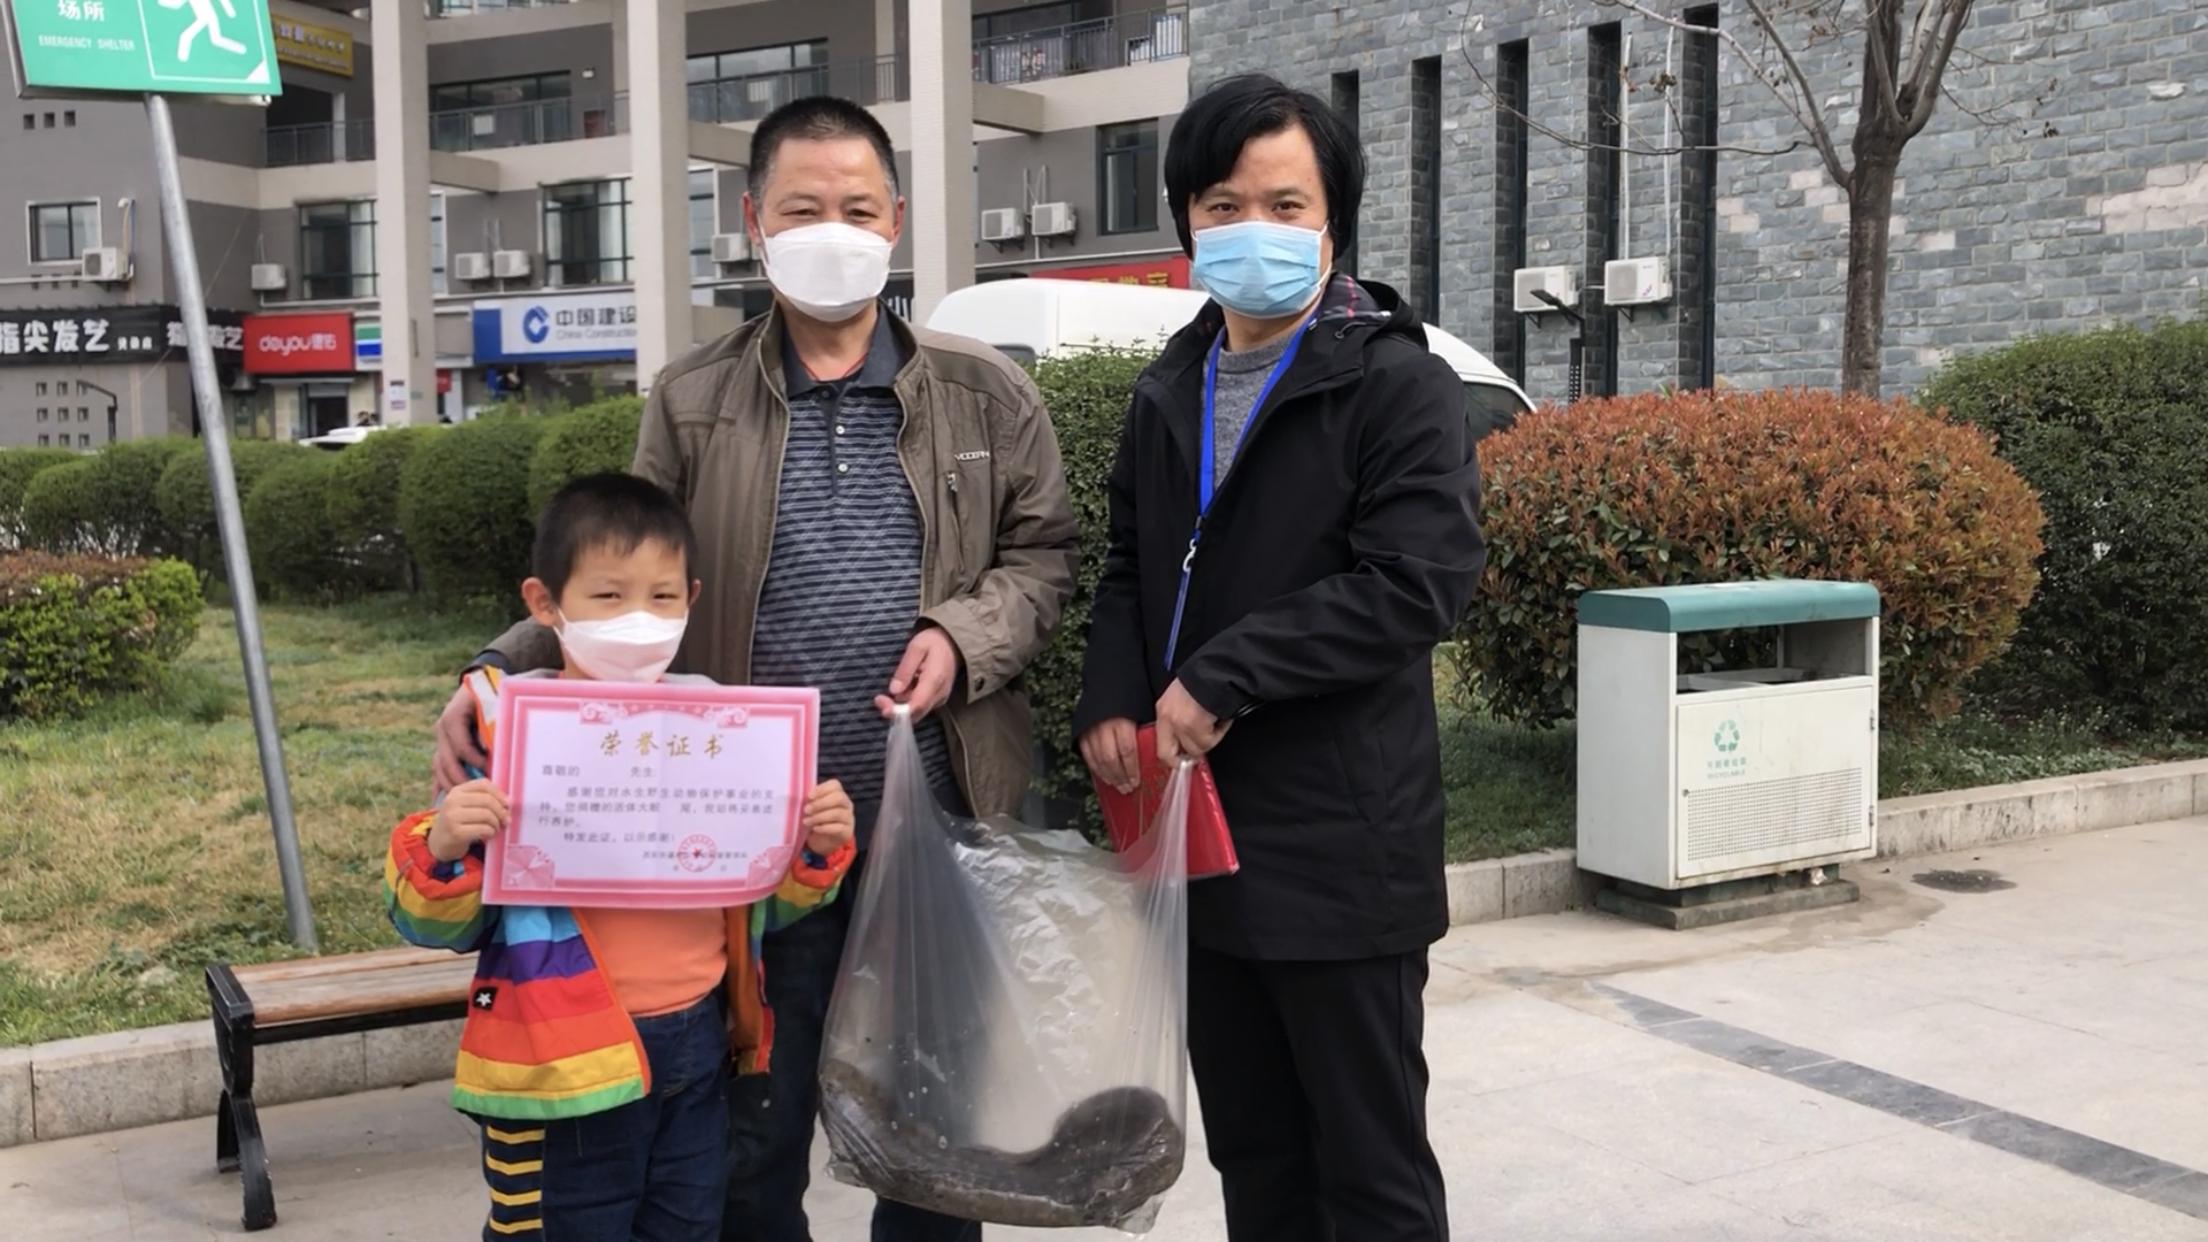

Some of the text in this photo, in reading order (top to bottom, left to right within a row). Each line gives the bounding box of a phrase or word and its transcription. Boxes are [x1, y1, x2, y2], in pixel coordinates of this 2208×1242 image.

[57, 0, 105, 21] 场所
[38, 35, 135, 51] EMERGENCY SHELTER
[556, 305, 636, 326] 中国建设
[0, 318, 110, 354] 指尖发艺
[599, 730, 723, 759] 荣誉证书
[542, 764, 580, 777] 尊敬的
